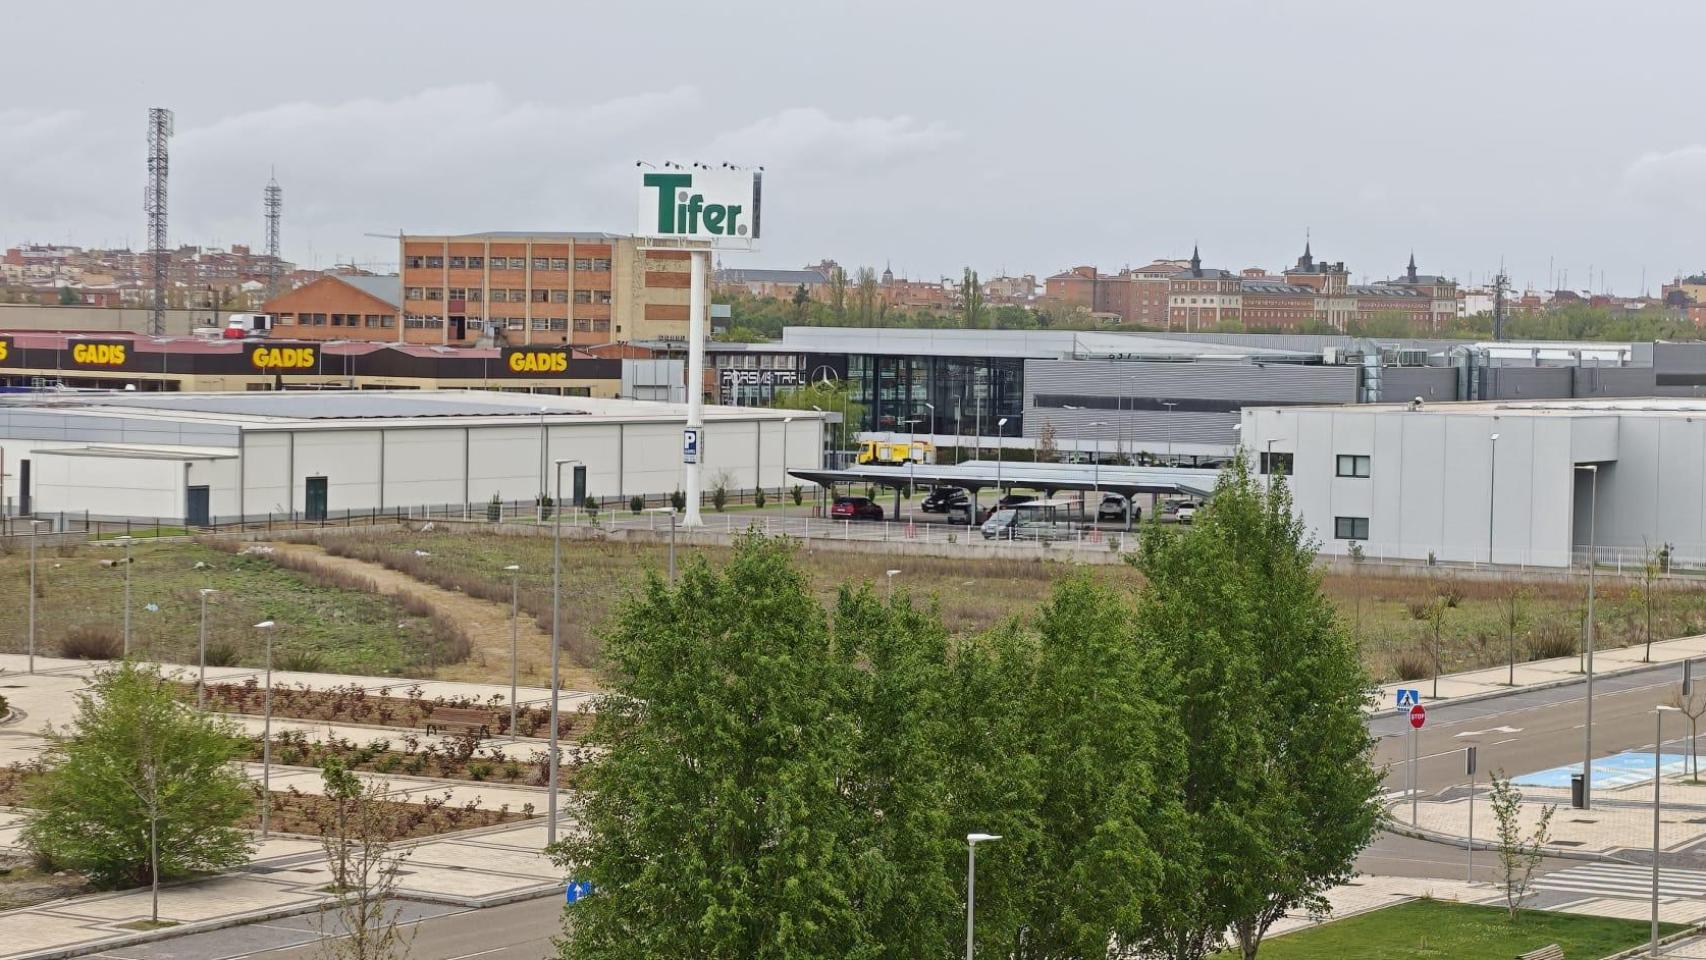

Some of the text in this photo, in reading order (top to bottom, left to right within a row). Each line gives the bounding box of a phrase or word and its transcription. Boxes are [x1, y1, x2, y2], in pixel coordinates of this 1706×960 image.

[73, 343, 126, 365] GADIS
[252, 347, 315, 368] GADIS
[509, 352, 568, 372] GADIS
[684, 432, 696, 449] P
[1411, 713, 1425, 721] STOP
